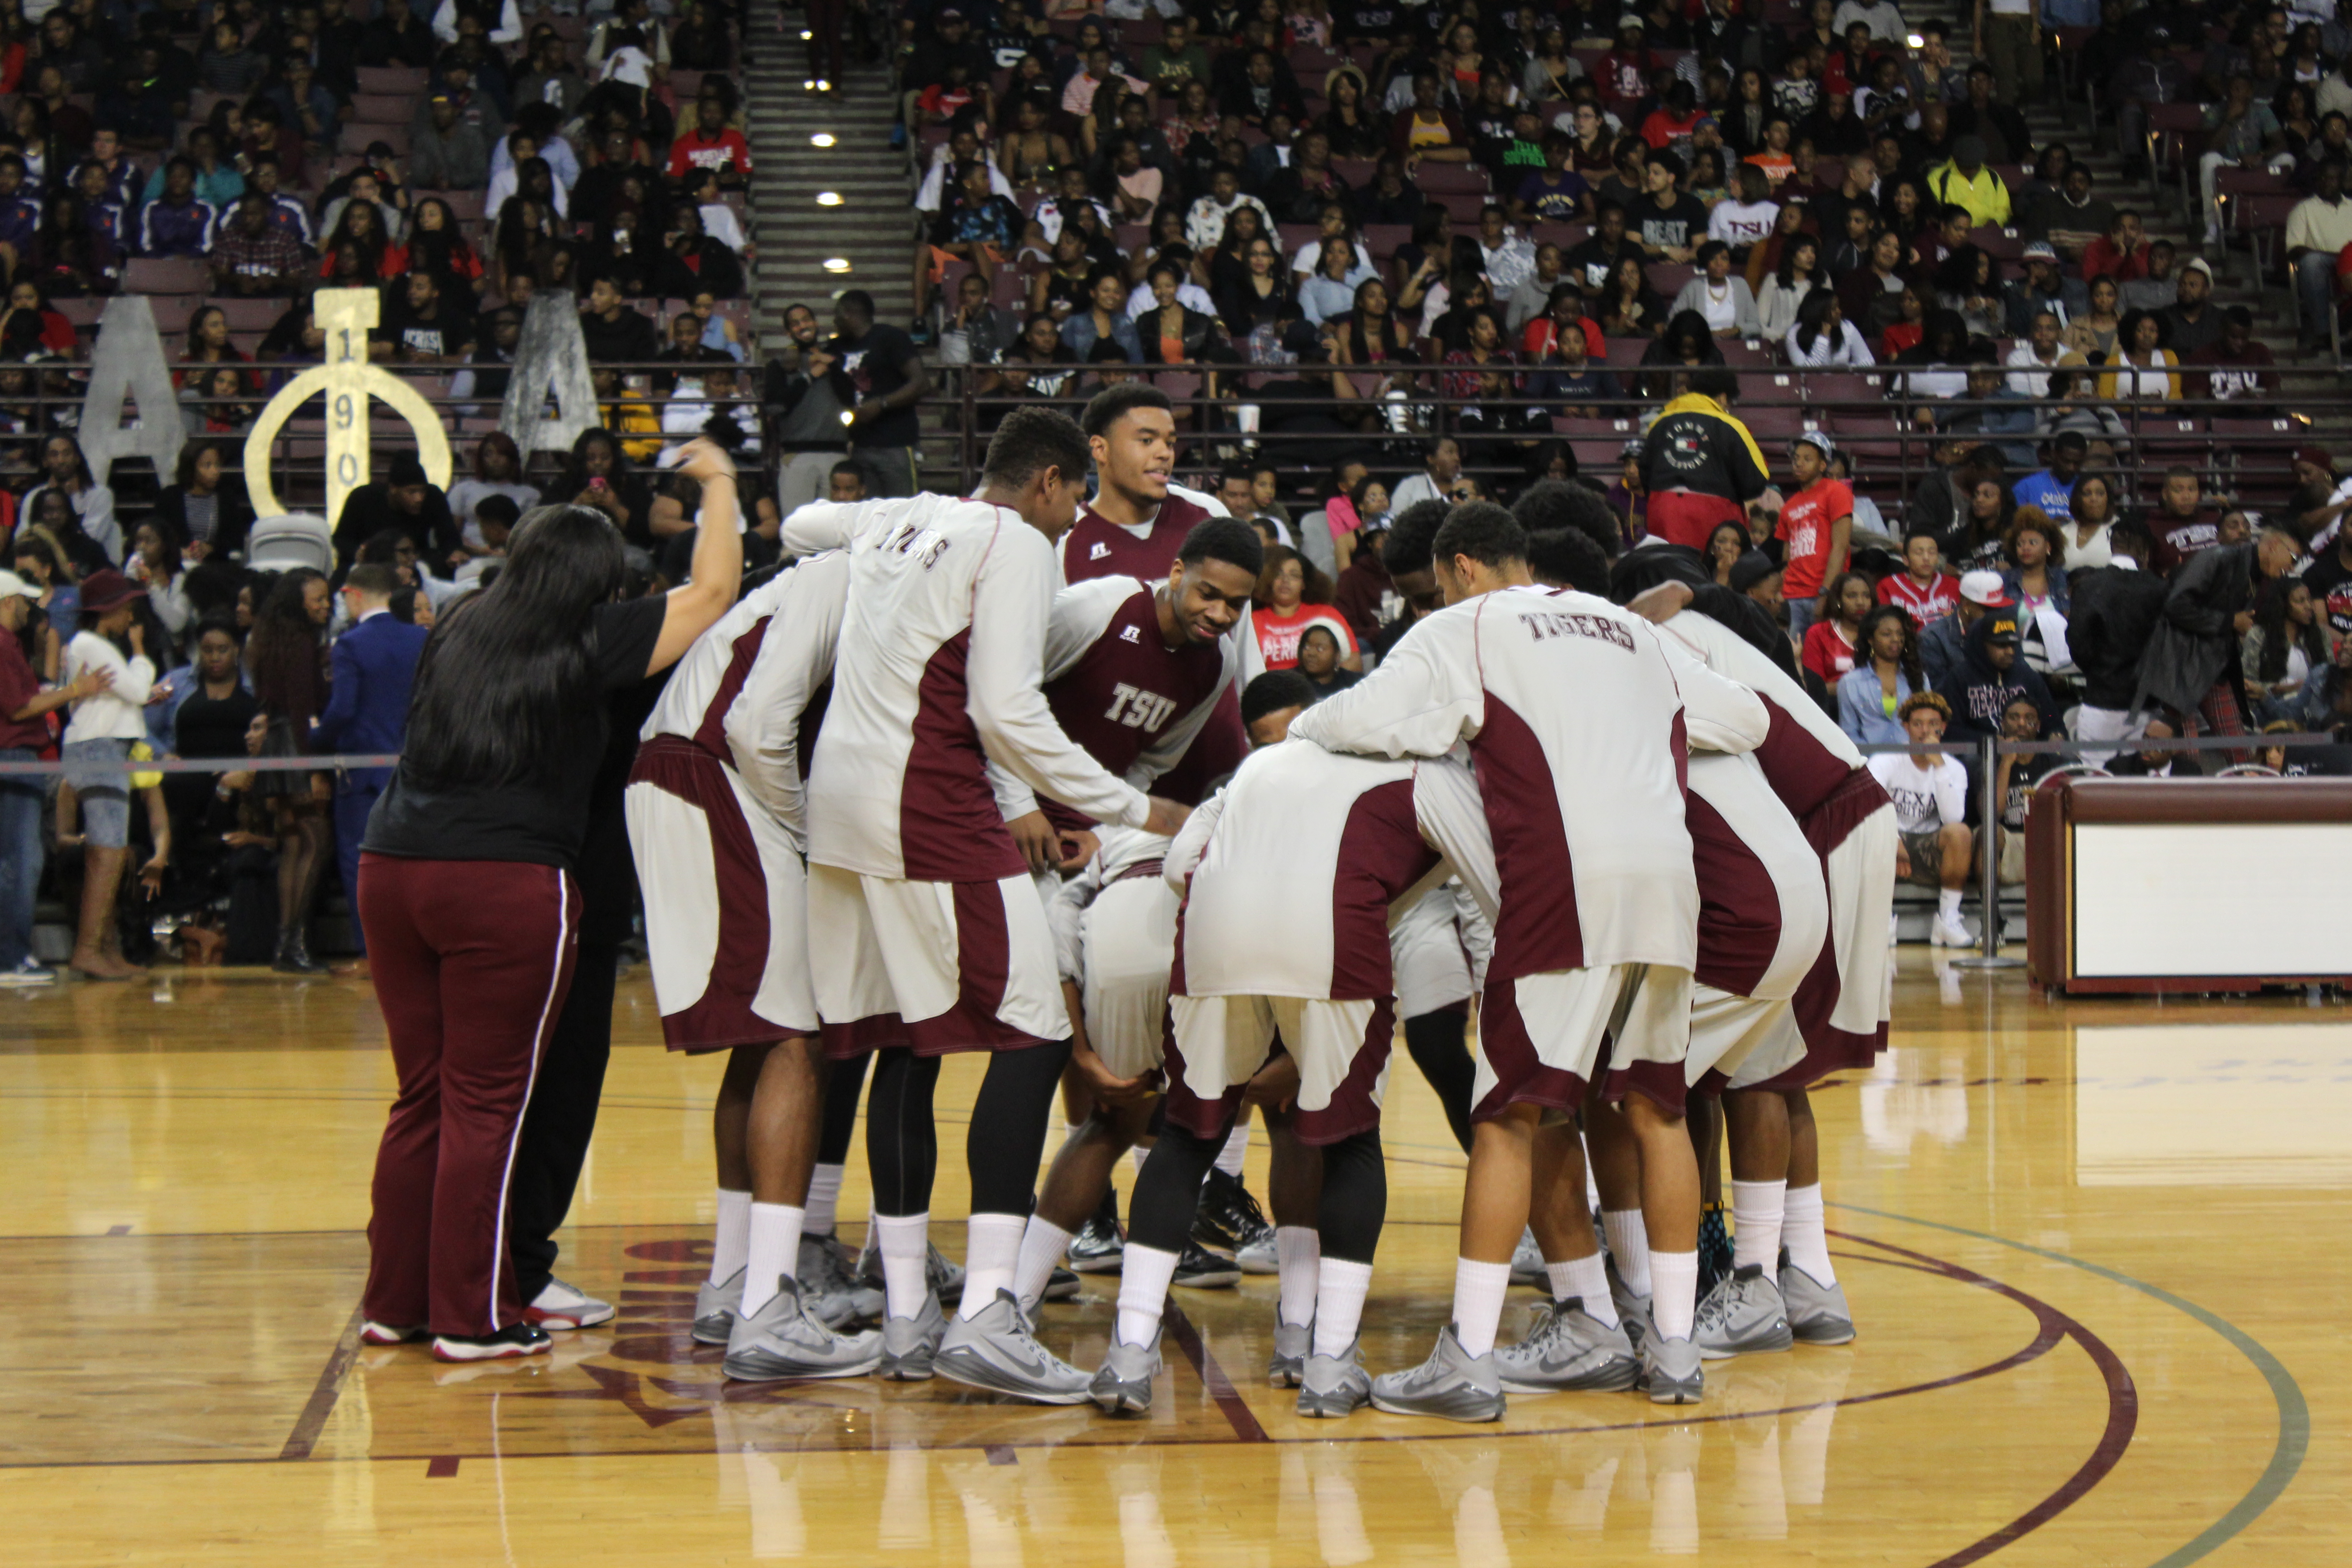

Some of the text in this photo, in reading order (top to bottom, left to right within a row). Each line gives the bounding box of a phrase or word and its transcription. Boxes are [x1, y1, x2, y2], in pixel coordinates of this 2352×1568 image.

[1643, 220, 1688, 247] BEAT
[1666, 421, 1710, 441] TOMMY
[1518, 611, 1637, 655] TIGERS
[1104, 682, 1177, 734] TSU
[1891, 788, 1938, 808] TEXA
